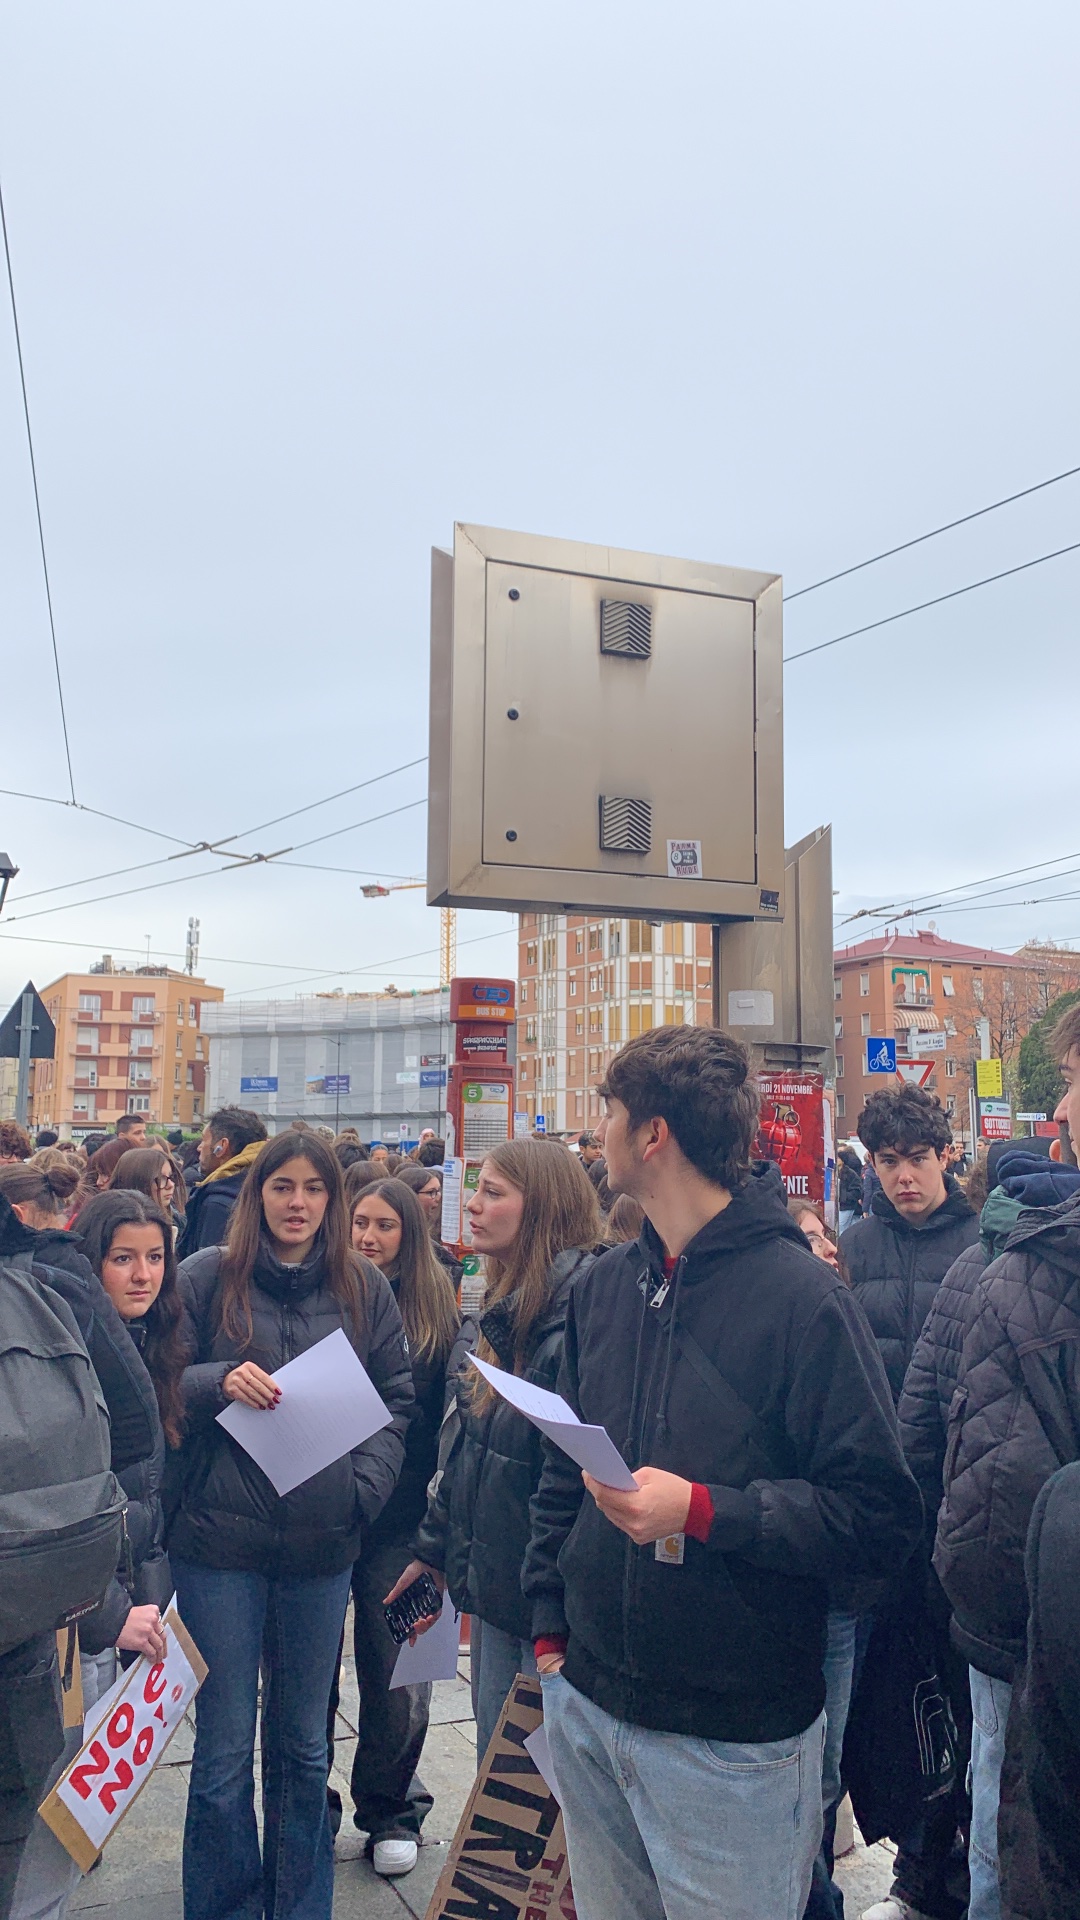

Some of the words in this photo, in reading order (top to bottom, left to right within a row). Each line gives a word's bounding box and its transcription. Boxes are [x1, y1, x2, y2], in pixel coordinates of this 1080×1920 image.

[476, 1007, 489, 1016] BUS
[491, 1007, 506, 1016] STOP
[467, 1089, 477, 1098] 5
[774, 1083, 780, 1093] 21
[781, 1084, 813, 1095] NOVEMBRE
[467, 1174, 477, 1184] 5
[466, 1261, 476, 1271] 7
[69, 1702, 134, 1800] NO
